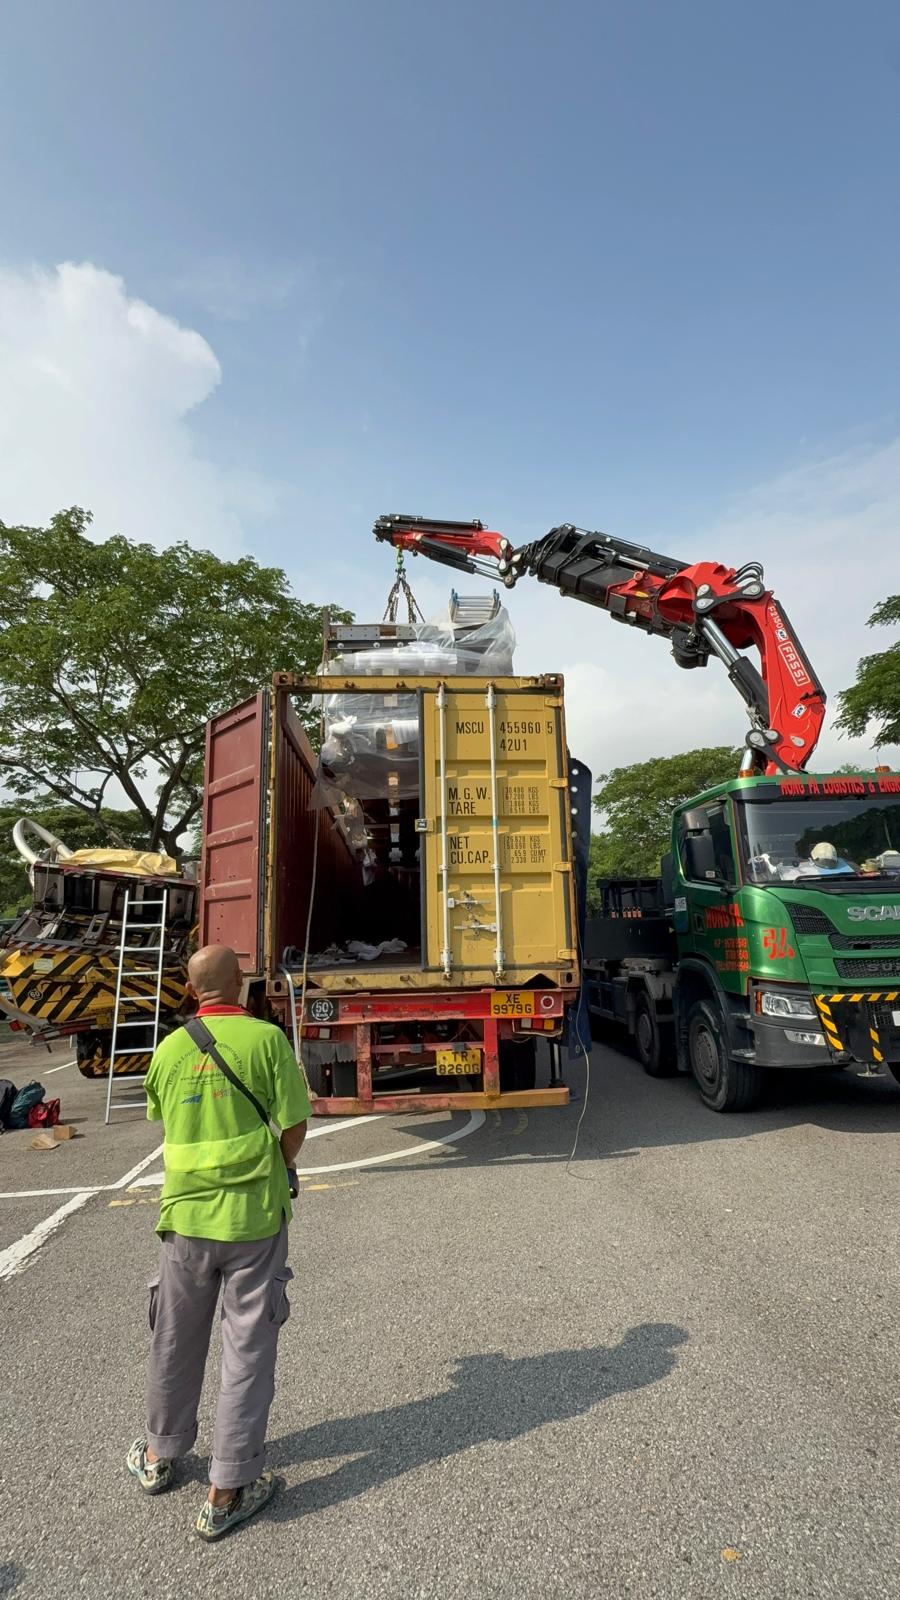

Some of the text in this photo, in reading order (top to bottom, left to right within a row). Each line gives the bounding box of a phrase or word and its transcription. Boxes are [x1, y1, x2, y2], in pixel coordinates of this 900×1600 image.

[783, 646, 806, 682] FASSI
[456, 721, 553, 734] MSCU 455960 5
[500, 739, 527, 751] 42U1
[779, 776, 805, 795] HONG
[807, 775, 820, 794] FA
[822, 775, 866, 794] LOGISTICS
[450, 801, 476, 815] TARE
[450, 836, 469, 850] NET
[450, 850, 491, 865] CU.CAP.
[506, 994, 520, 1003] XE
[315, 1001, 329, 1012] 50
[493, 1004, 532, 1014] 9979G
[452, 1051, 469, 1061] TR
[439, 1064, 480, 1075] 8260G
